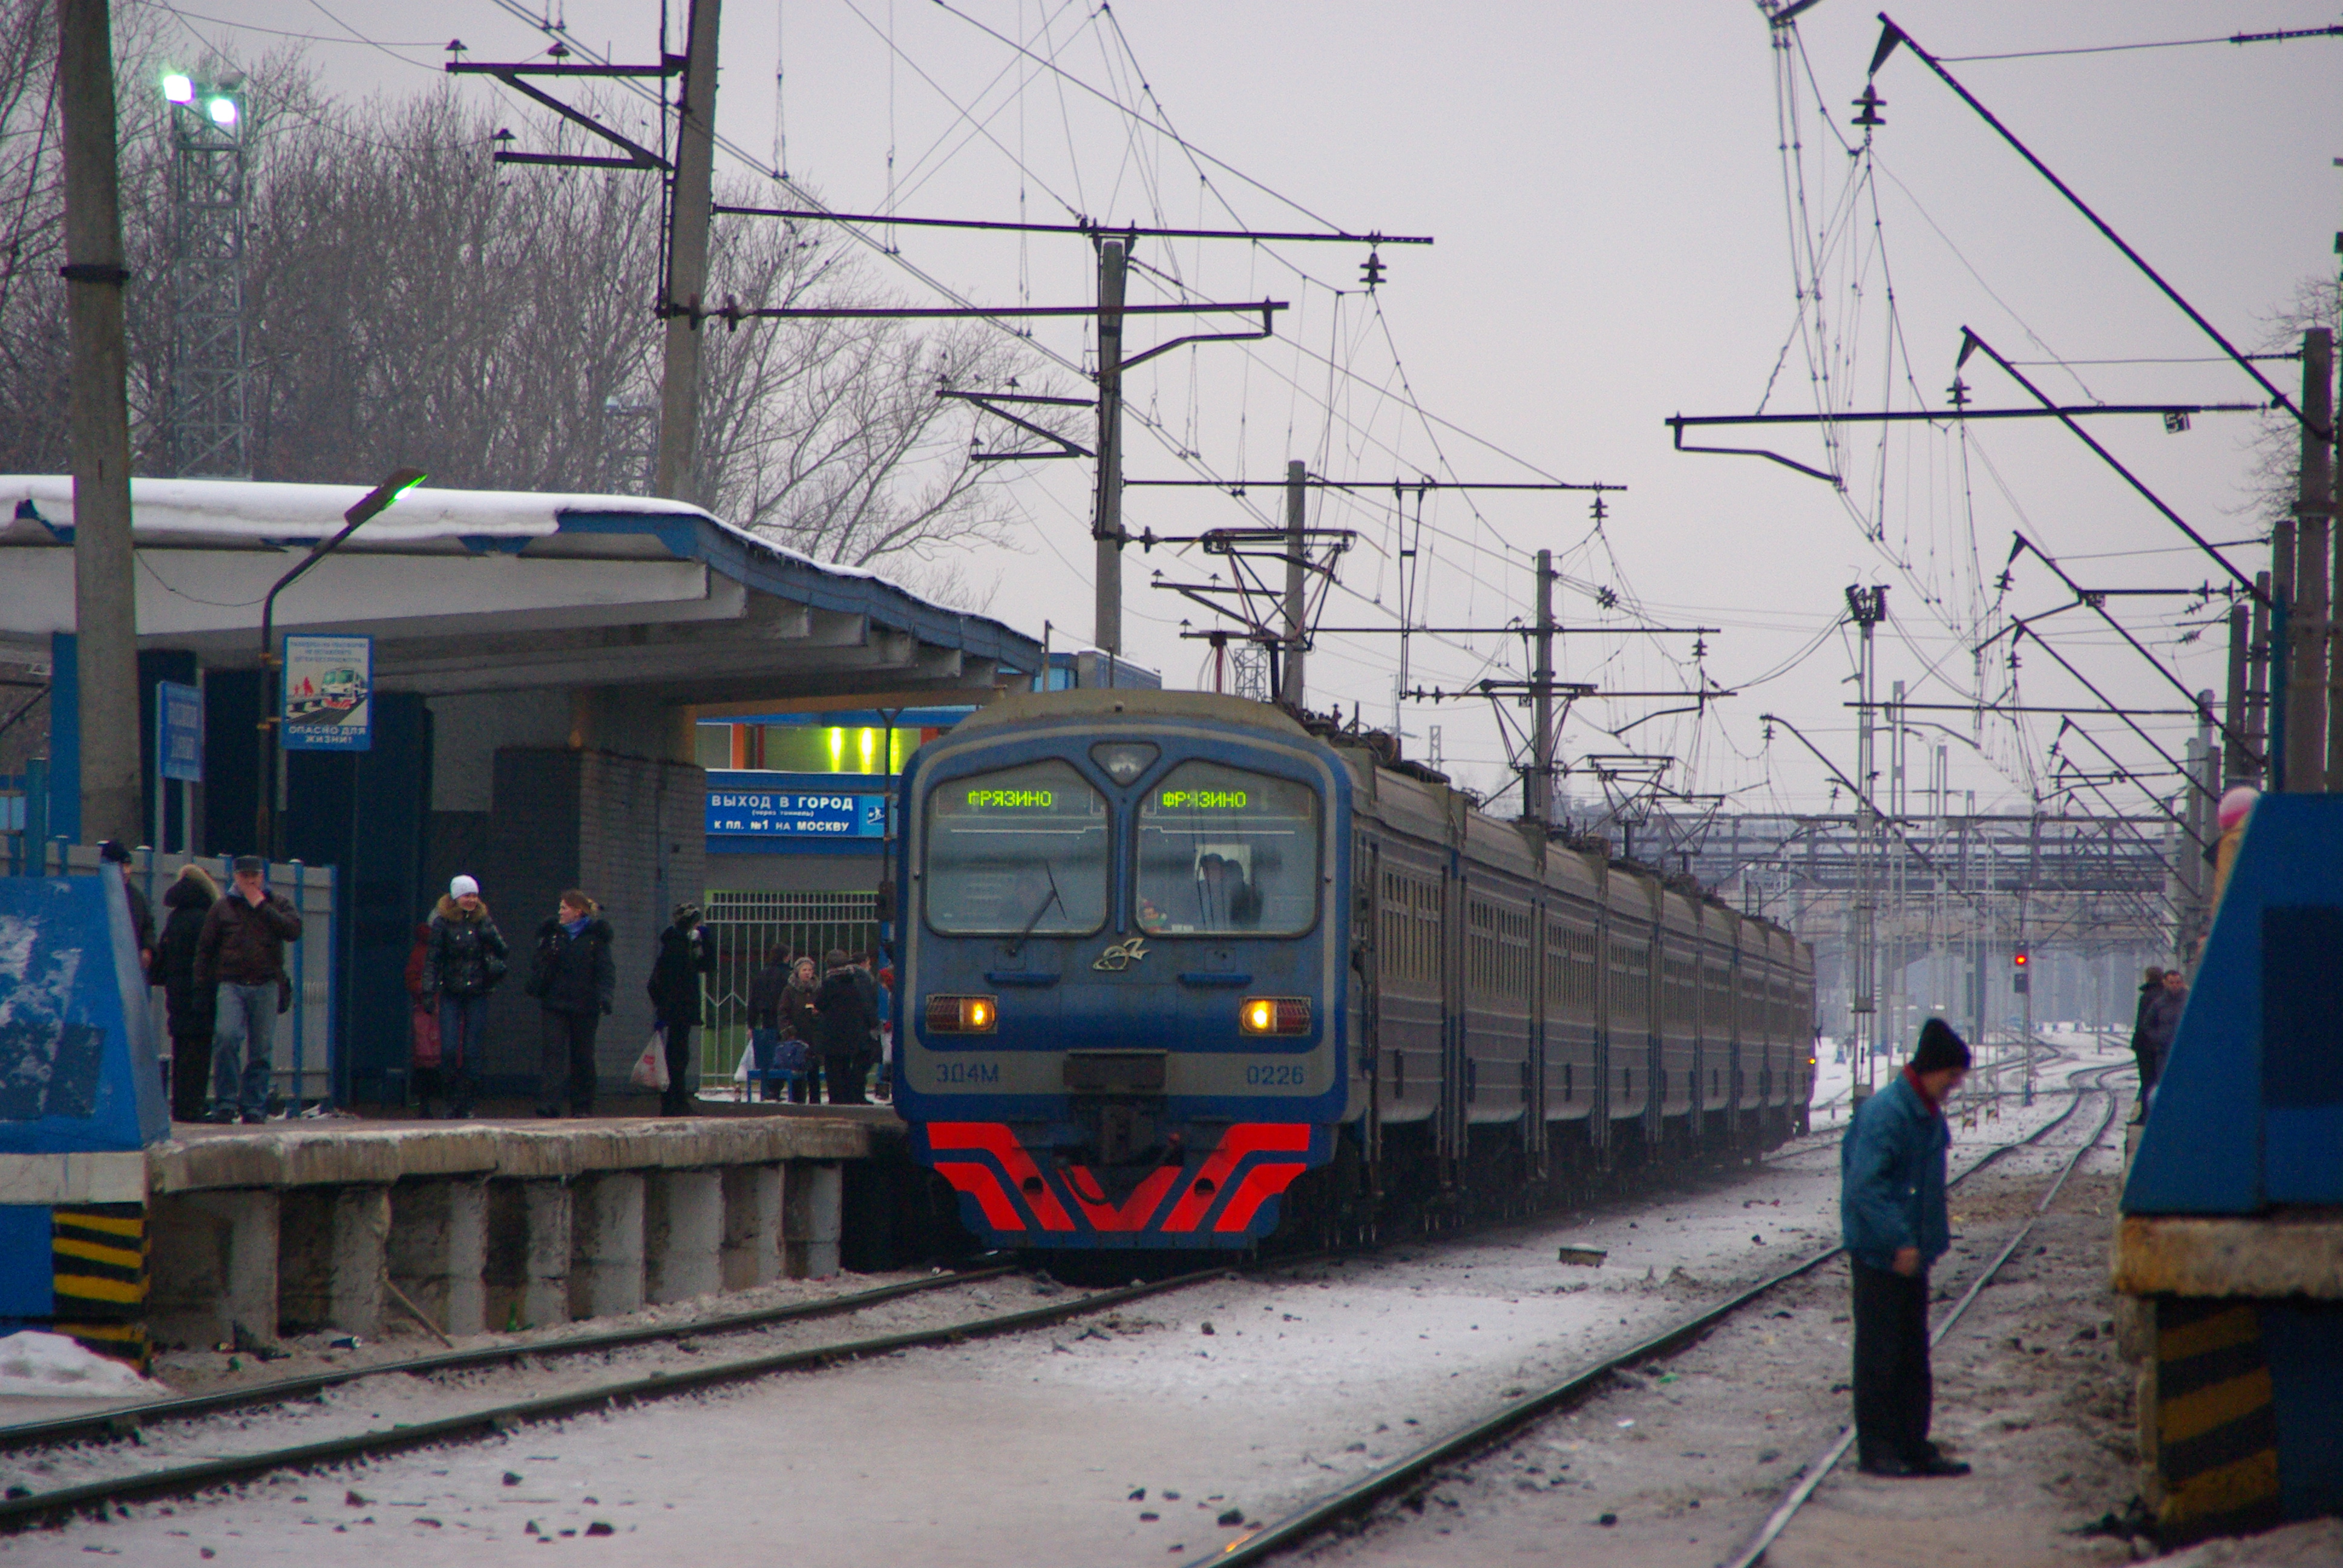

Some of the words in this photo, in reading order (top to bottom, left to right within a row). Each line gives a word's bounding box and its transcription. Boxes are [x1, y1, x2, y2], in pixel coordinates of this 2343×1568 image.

[289, 726, 339, 734] ОПАСНО
[341, 727, 365, 736] ДЛЯ
[305, 735, 352, 743] ЖИЗНИ!
[712, 795, 771, 809] ВЫХОД
[779, 796, 789, 808] В
[798, 797, 853, 811] ГОРОД
[775, 822, 791, 831] НА
[796, 821, 850, 832] МОСКВУ
[1248, 1065, 1304, 1085] 0226
